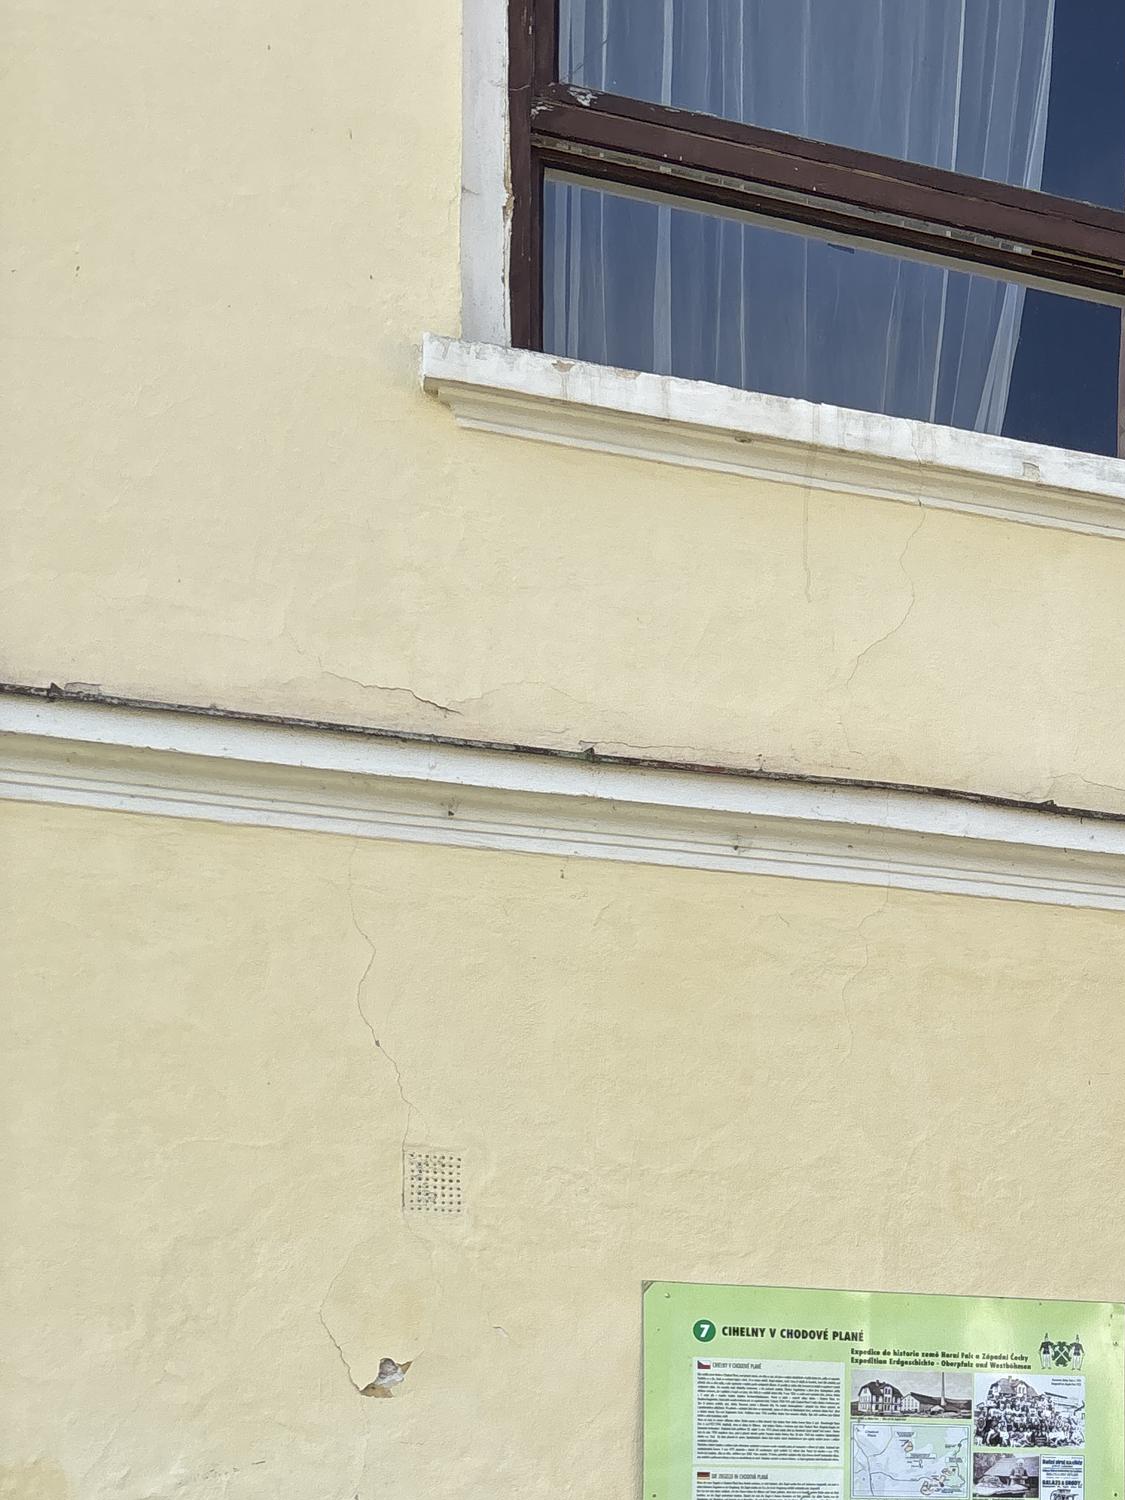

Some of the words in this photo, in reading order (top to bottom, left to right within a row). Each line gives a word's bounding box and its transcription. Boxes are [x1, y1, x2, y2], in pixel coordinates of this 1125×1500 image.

[700, 1324, 710, 1337] 7
[722, 1326, 766, 1338] CIHELNY
[769, 1328, 777, 1338] V
[780, 1328, 829, 1341] CHODOVÉ
[832, 1330, 864, 1342] PLANÉ
[850, 1348, 881, 1356] Expedice
[850, 1357, 888, 1366] Expedition
